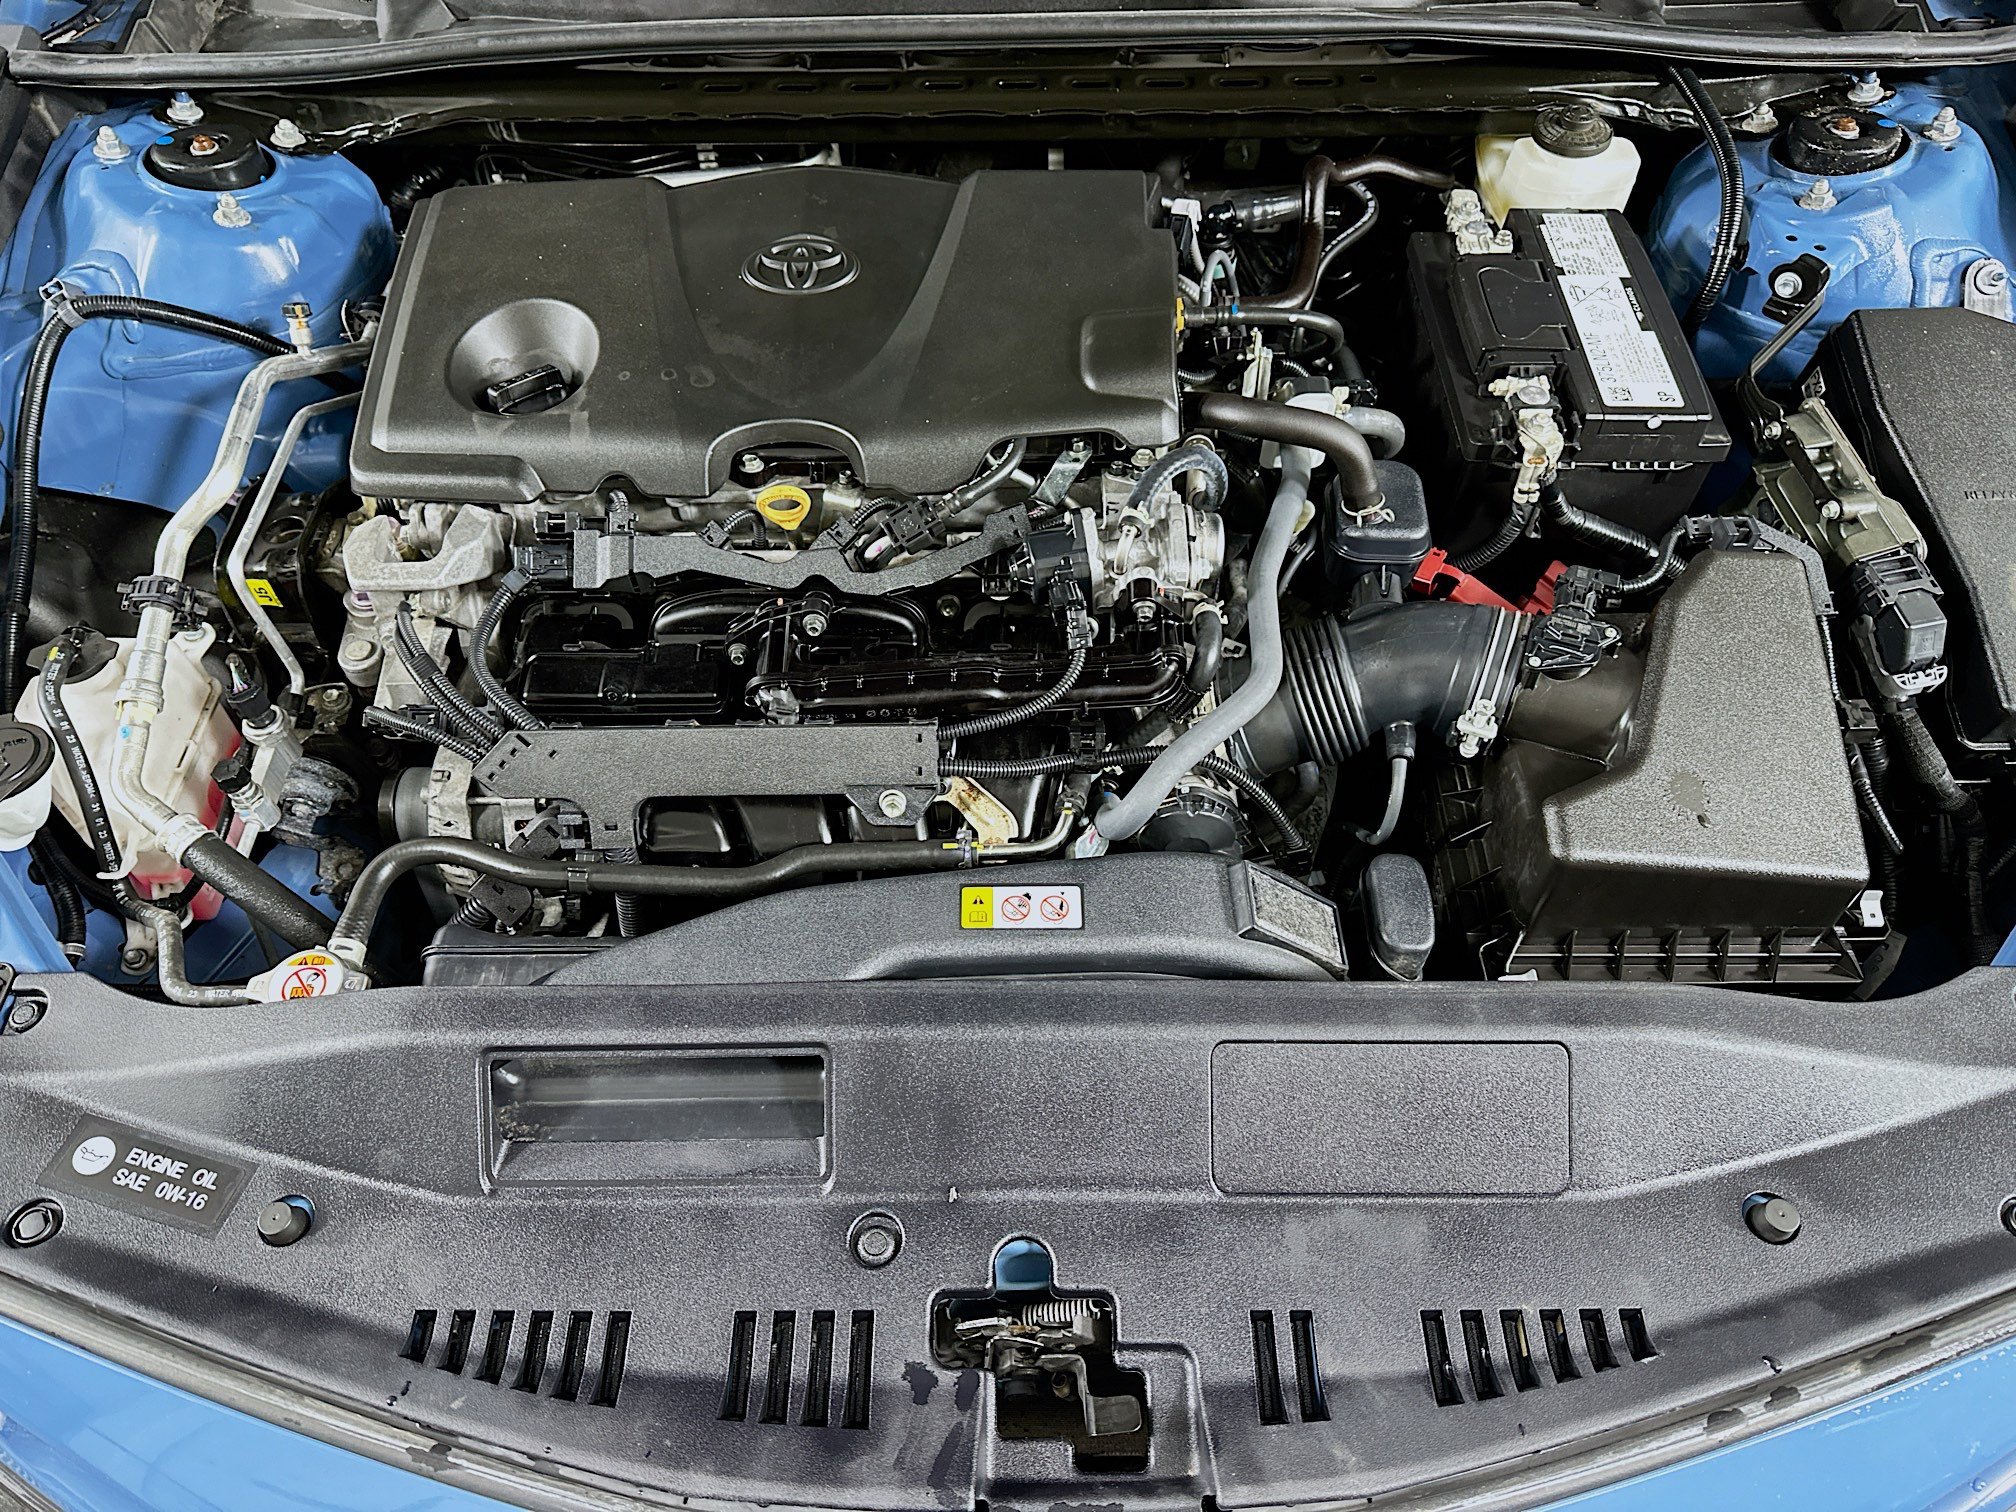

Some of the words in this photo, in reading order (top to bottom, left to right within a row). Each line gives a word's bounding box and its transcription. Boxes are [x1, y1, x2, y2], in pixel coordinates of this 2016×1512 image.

[1625, 286, 1641, 313] CLARIOS
[1658, 391, 1675, 402] SP
[253, 587, 273, 602] J5
[66, 734, 77, 744] 23
[71, 745, 87, 770] WATER
[102, 842, 116, 866] WATER
[124, 1147, 189, 1180] ENGINE
[191, 1168, 218, 1191] OIL
[112, 1168, 151, 1192] SAE
[154, 1181, 209, 1211] 0W-16
